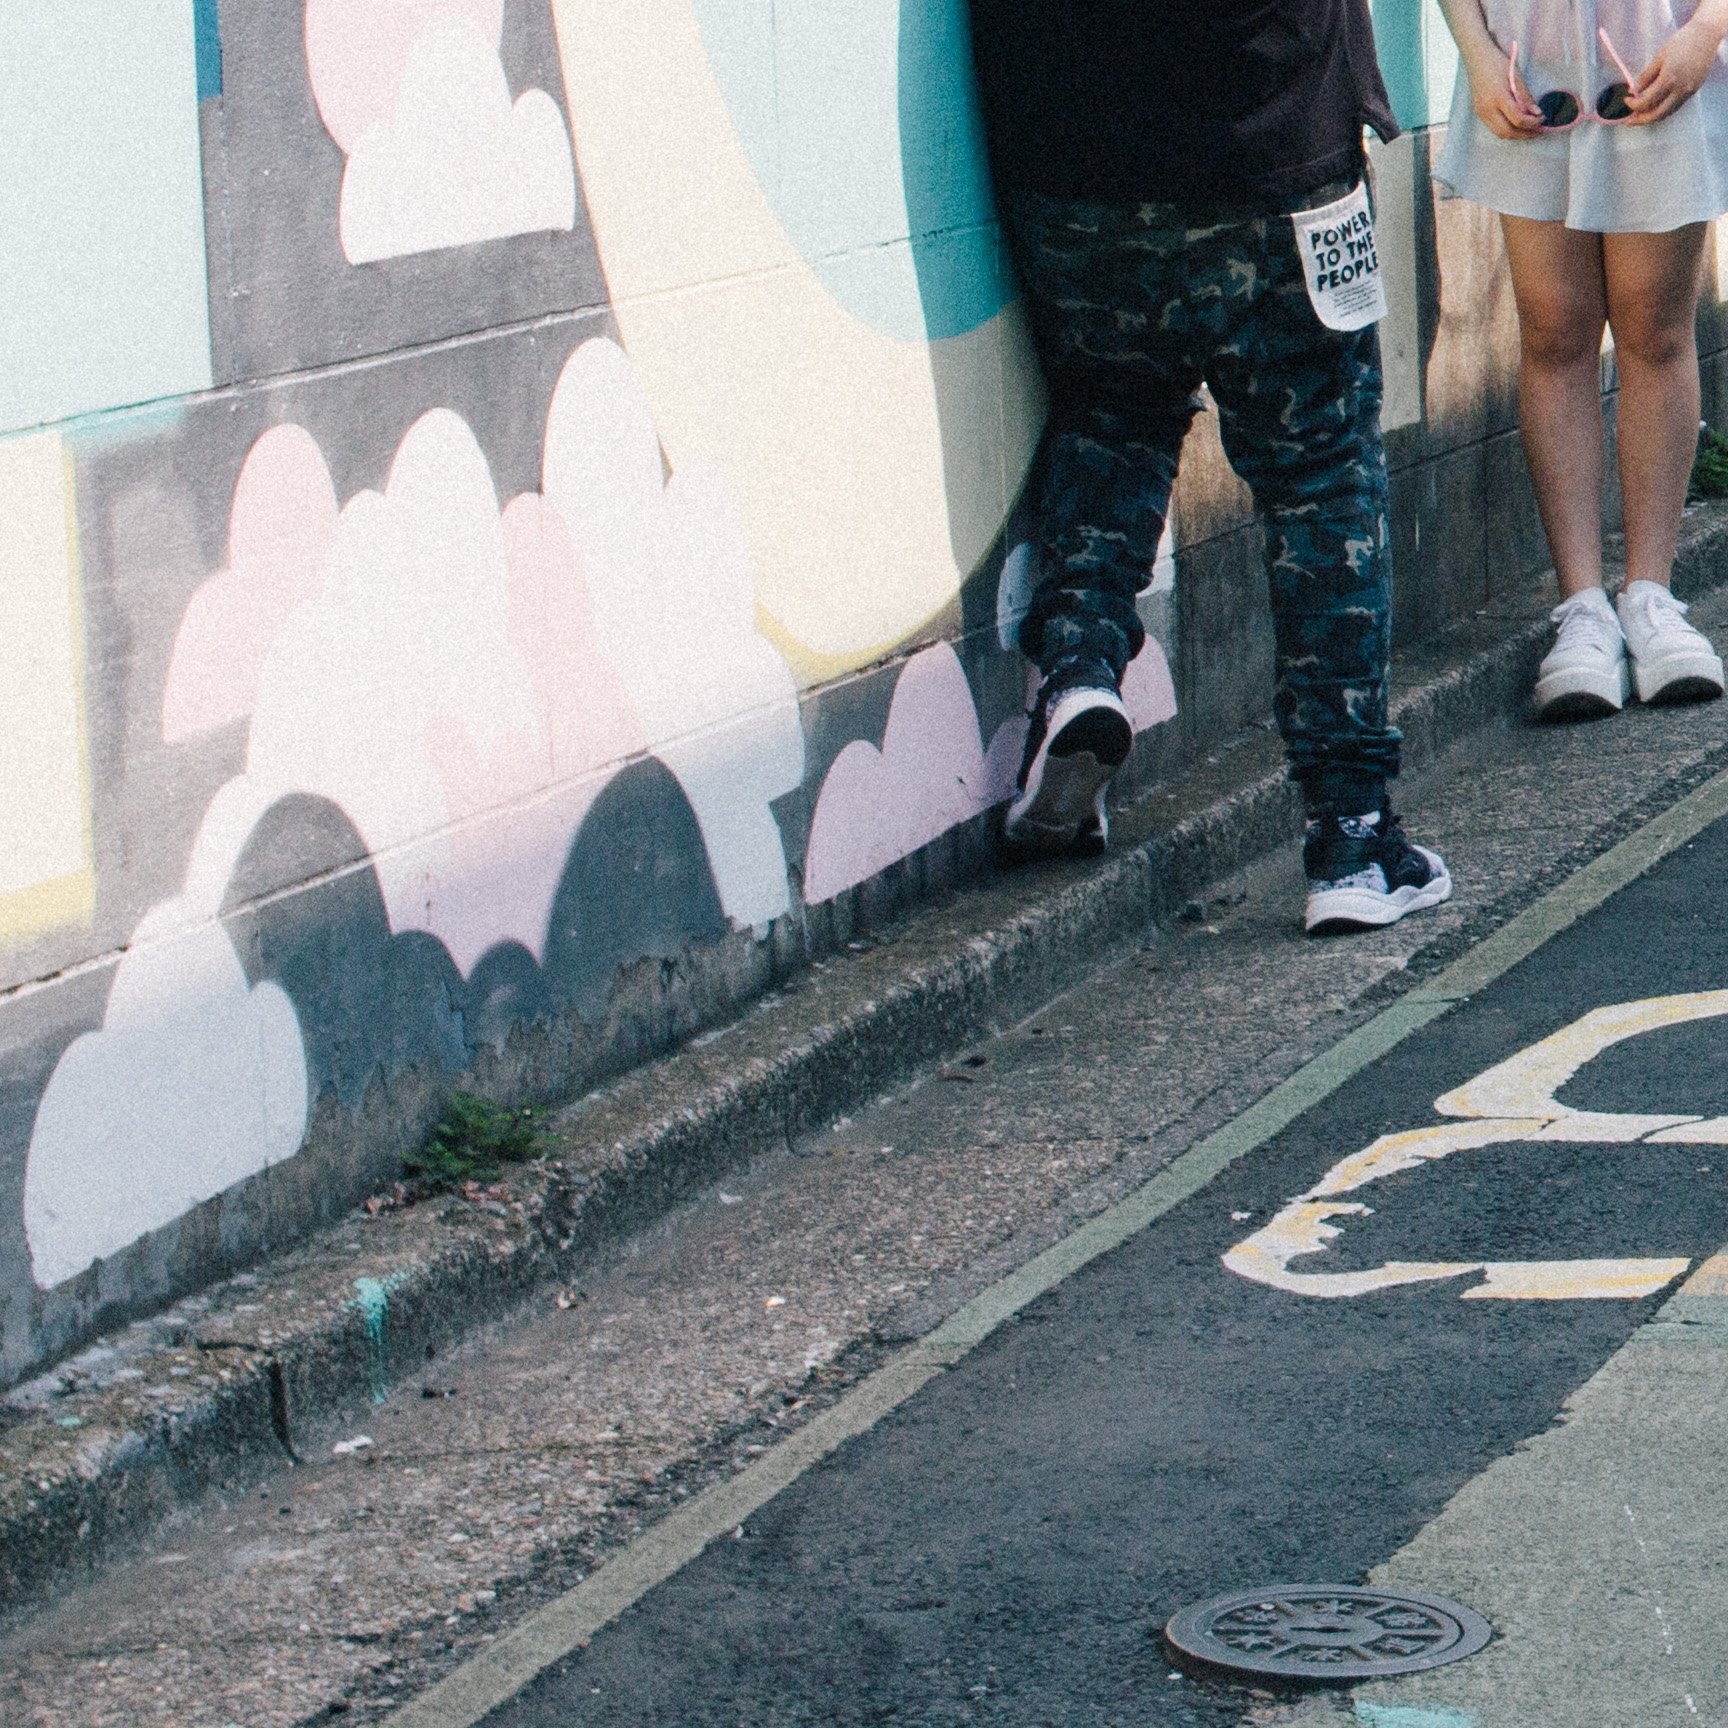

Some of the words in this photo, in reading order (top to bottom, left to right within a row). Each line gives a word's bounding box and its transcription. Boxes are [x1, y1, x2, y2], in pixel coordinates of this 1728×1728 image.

[1310, 210, 1370, 251] POWER
[1315, 248, 1341, 271] TO
[1346, 230, 1374, 260] THE
[1316, 250, 1379, 293] PEOPLE
